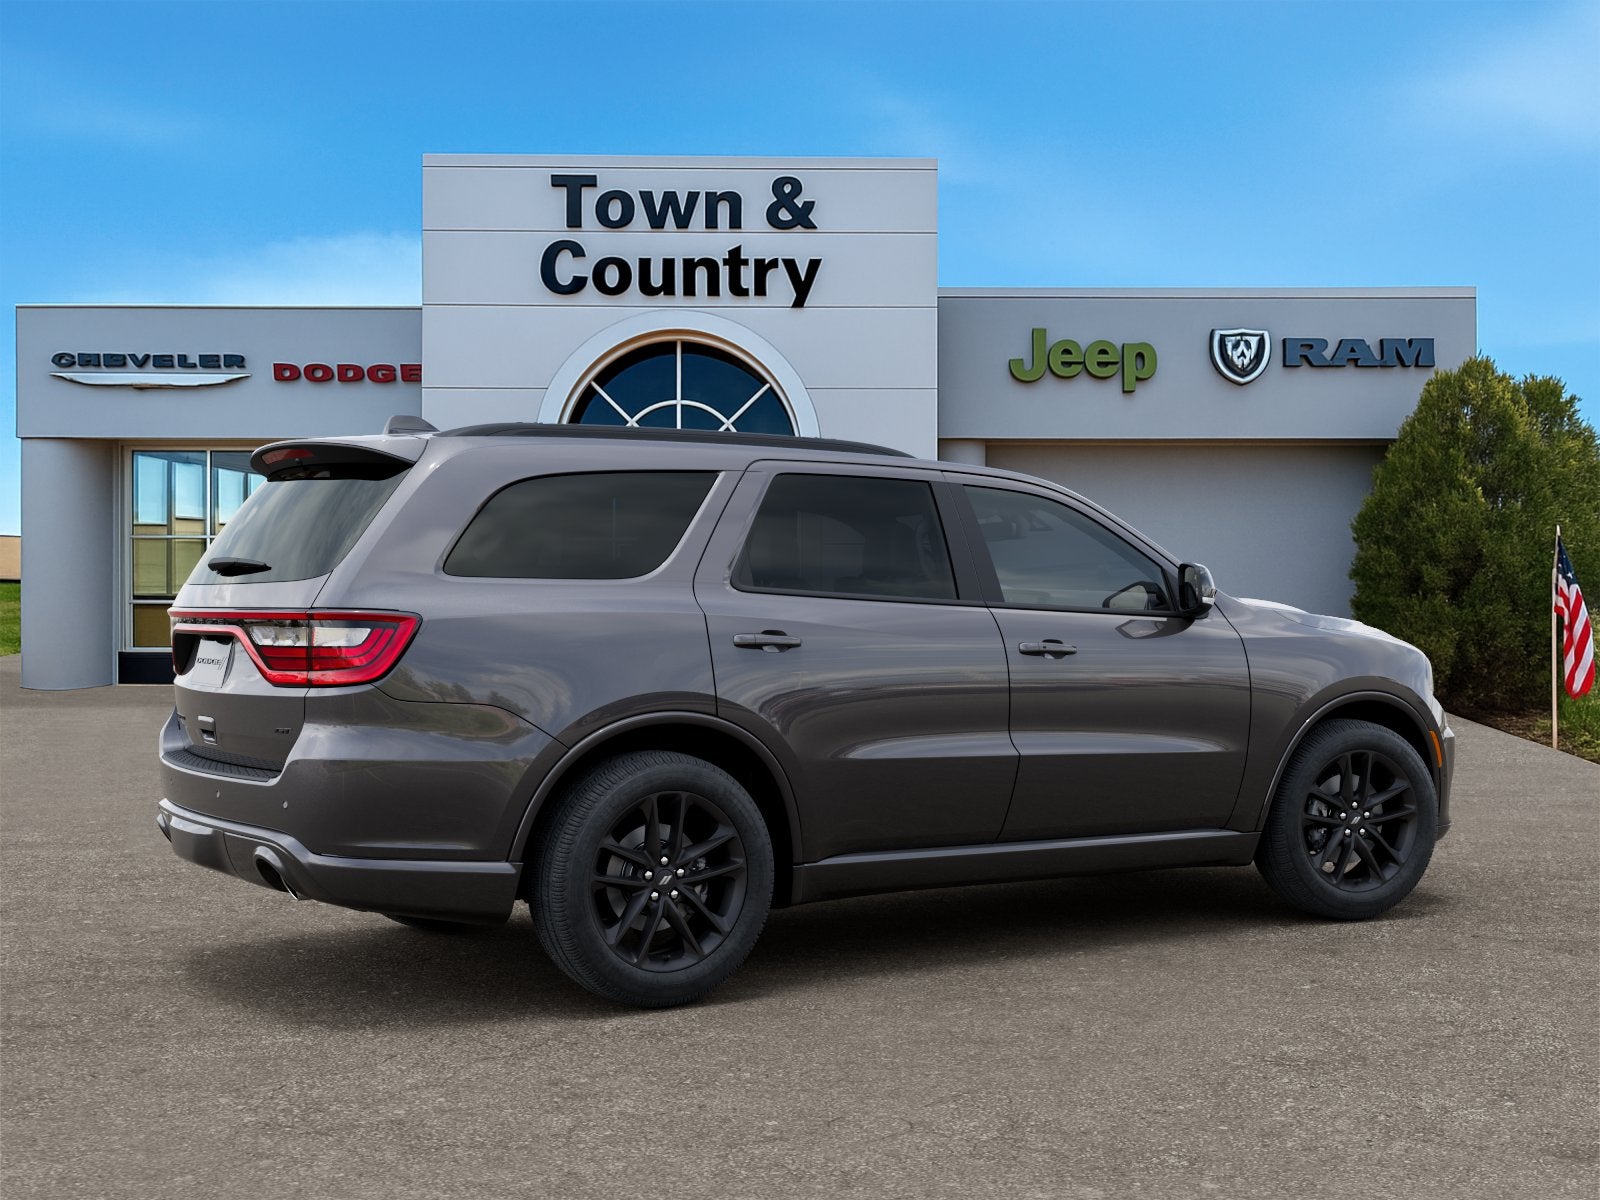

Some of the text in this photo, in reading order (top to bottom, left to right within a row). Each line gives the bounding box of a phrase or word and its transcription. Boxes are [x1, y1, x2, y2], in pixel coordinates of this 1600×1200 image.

[550, 174, 818, 230] Town &
[540, 239, 822, 308] Country
[273, 362, 422, 384] DODGE
[1009, 327, 1158, 394] Jeep
[1282, 337, 1436, 369] RAM
